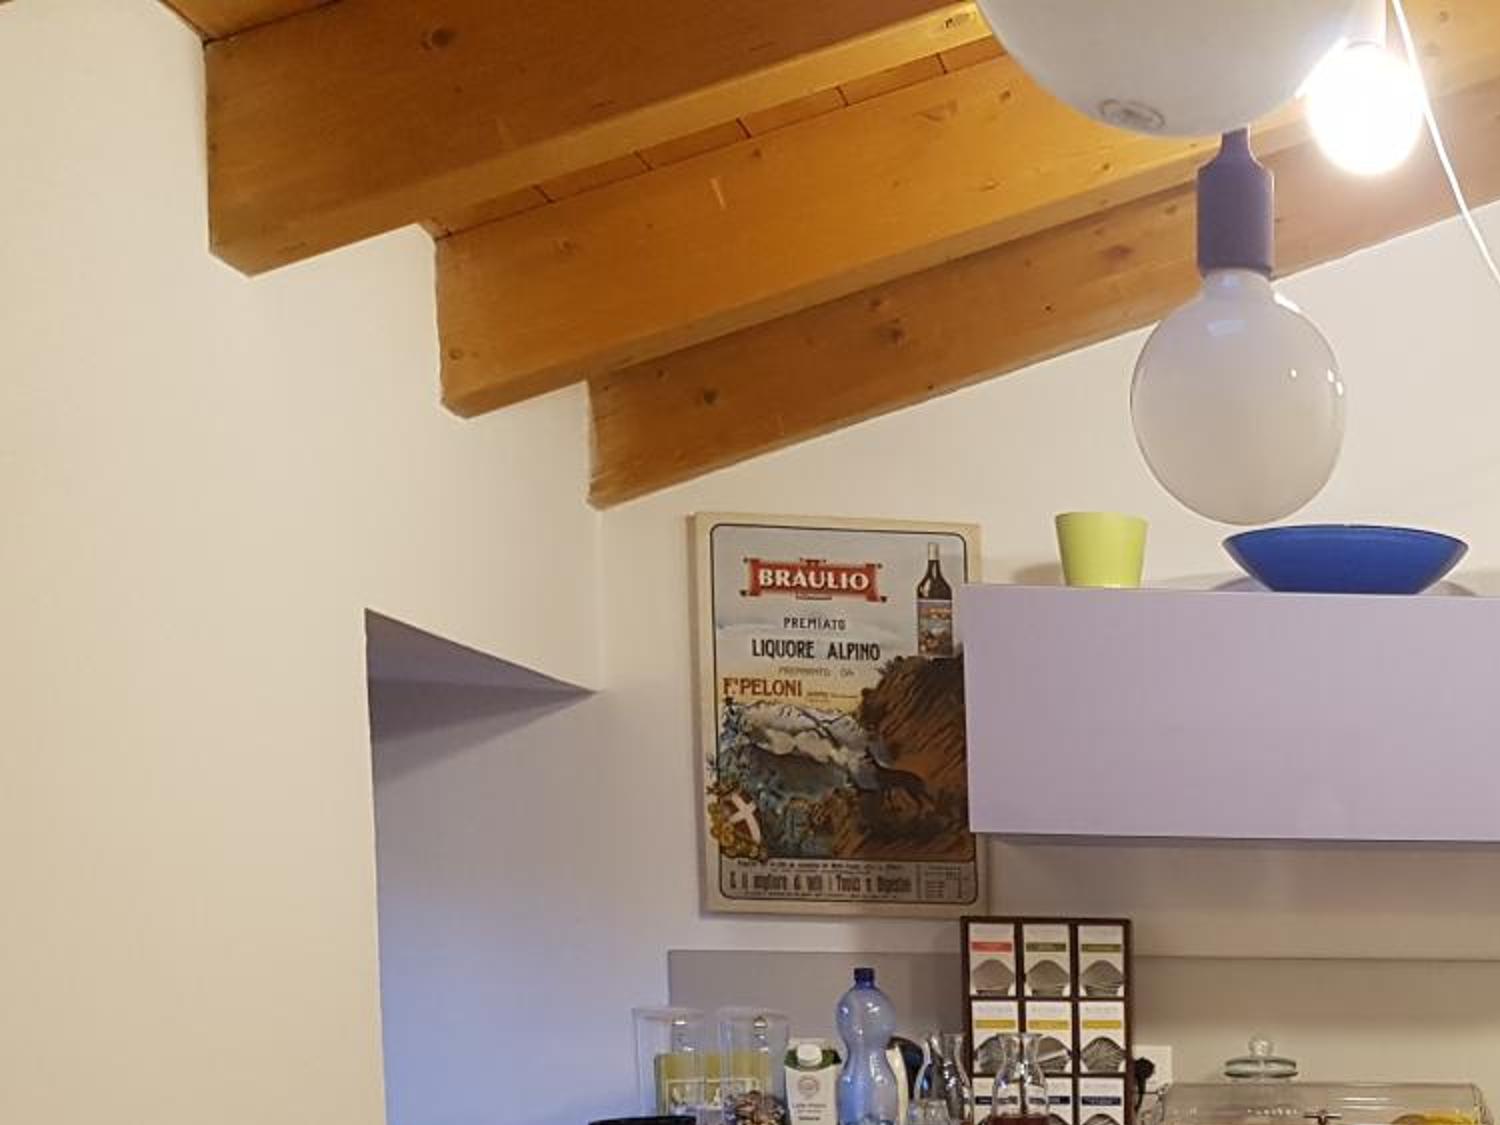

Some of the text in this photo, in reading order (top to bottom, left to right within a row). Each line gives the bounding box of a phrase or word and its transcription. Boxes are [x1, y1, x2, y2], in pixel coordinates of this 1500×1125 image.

[758, 568, 870, 591] BRAULIO
[783, 616, 847, 631] PREMIATO
[751, 639, 881, 661] LIQUORE ALPINO
